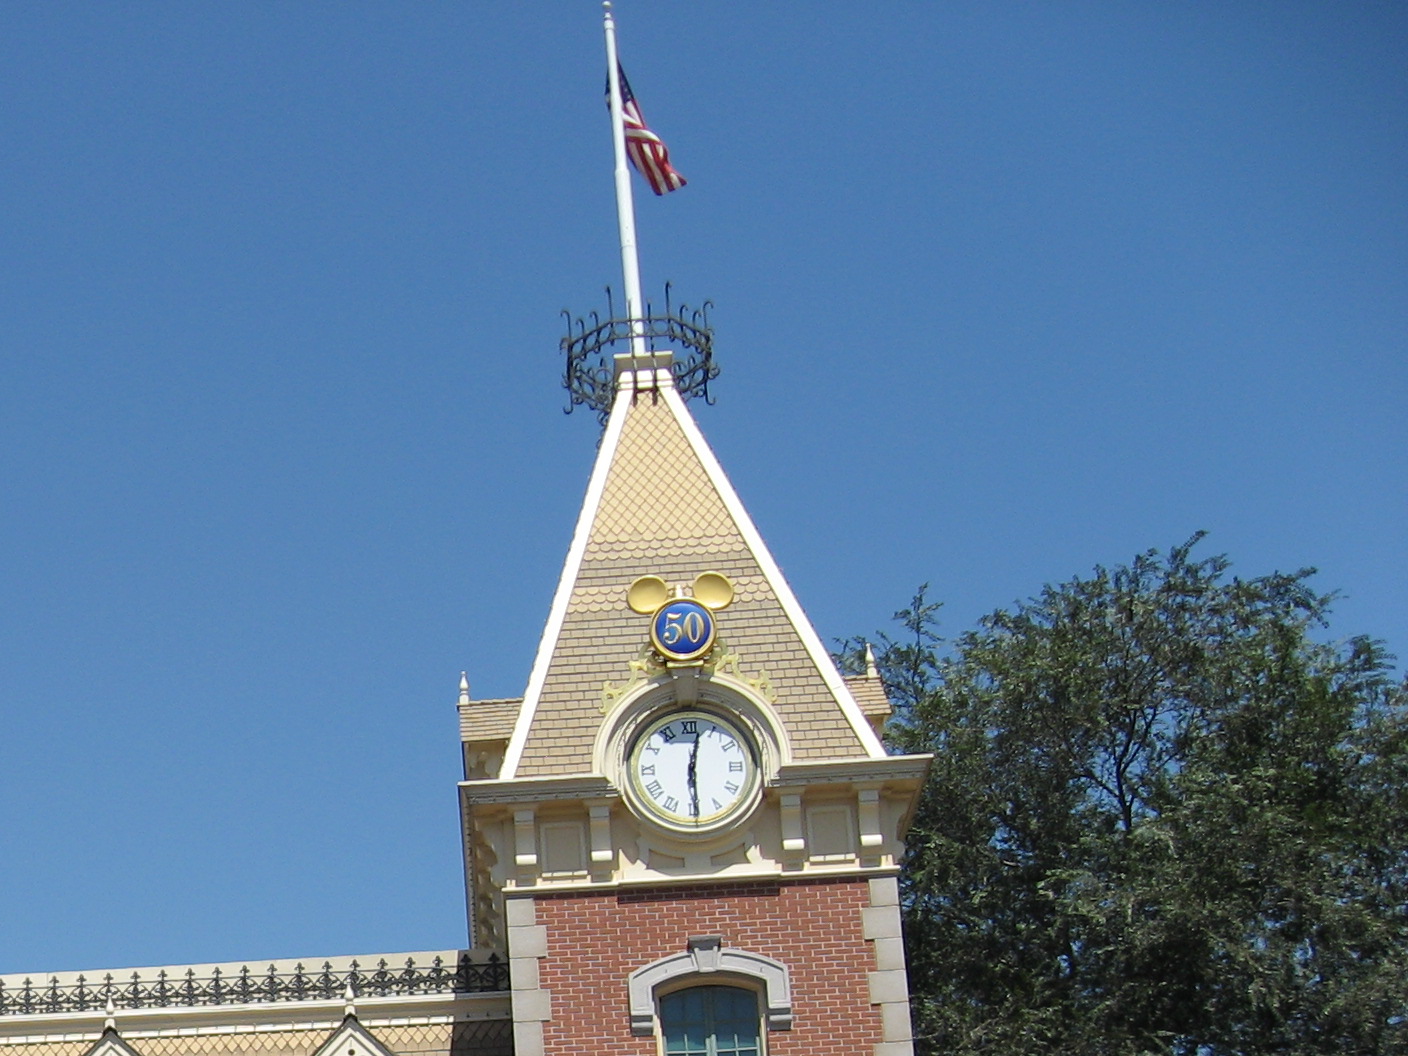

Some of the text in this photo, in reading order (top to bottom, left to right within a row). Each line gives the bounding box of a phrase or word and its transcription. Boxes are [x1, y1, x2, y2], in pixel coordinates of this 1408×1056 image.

[663, 611, 705, 644] 50
[660, 726, 676, 742] XI
[681, 721, 697, 734] XII
[721, 740, 735, 752] II
[729, 761, 743, 772] III
[724, 780, 739, 795] IV
